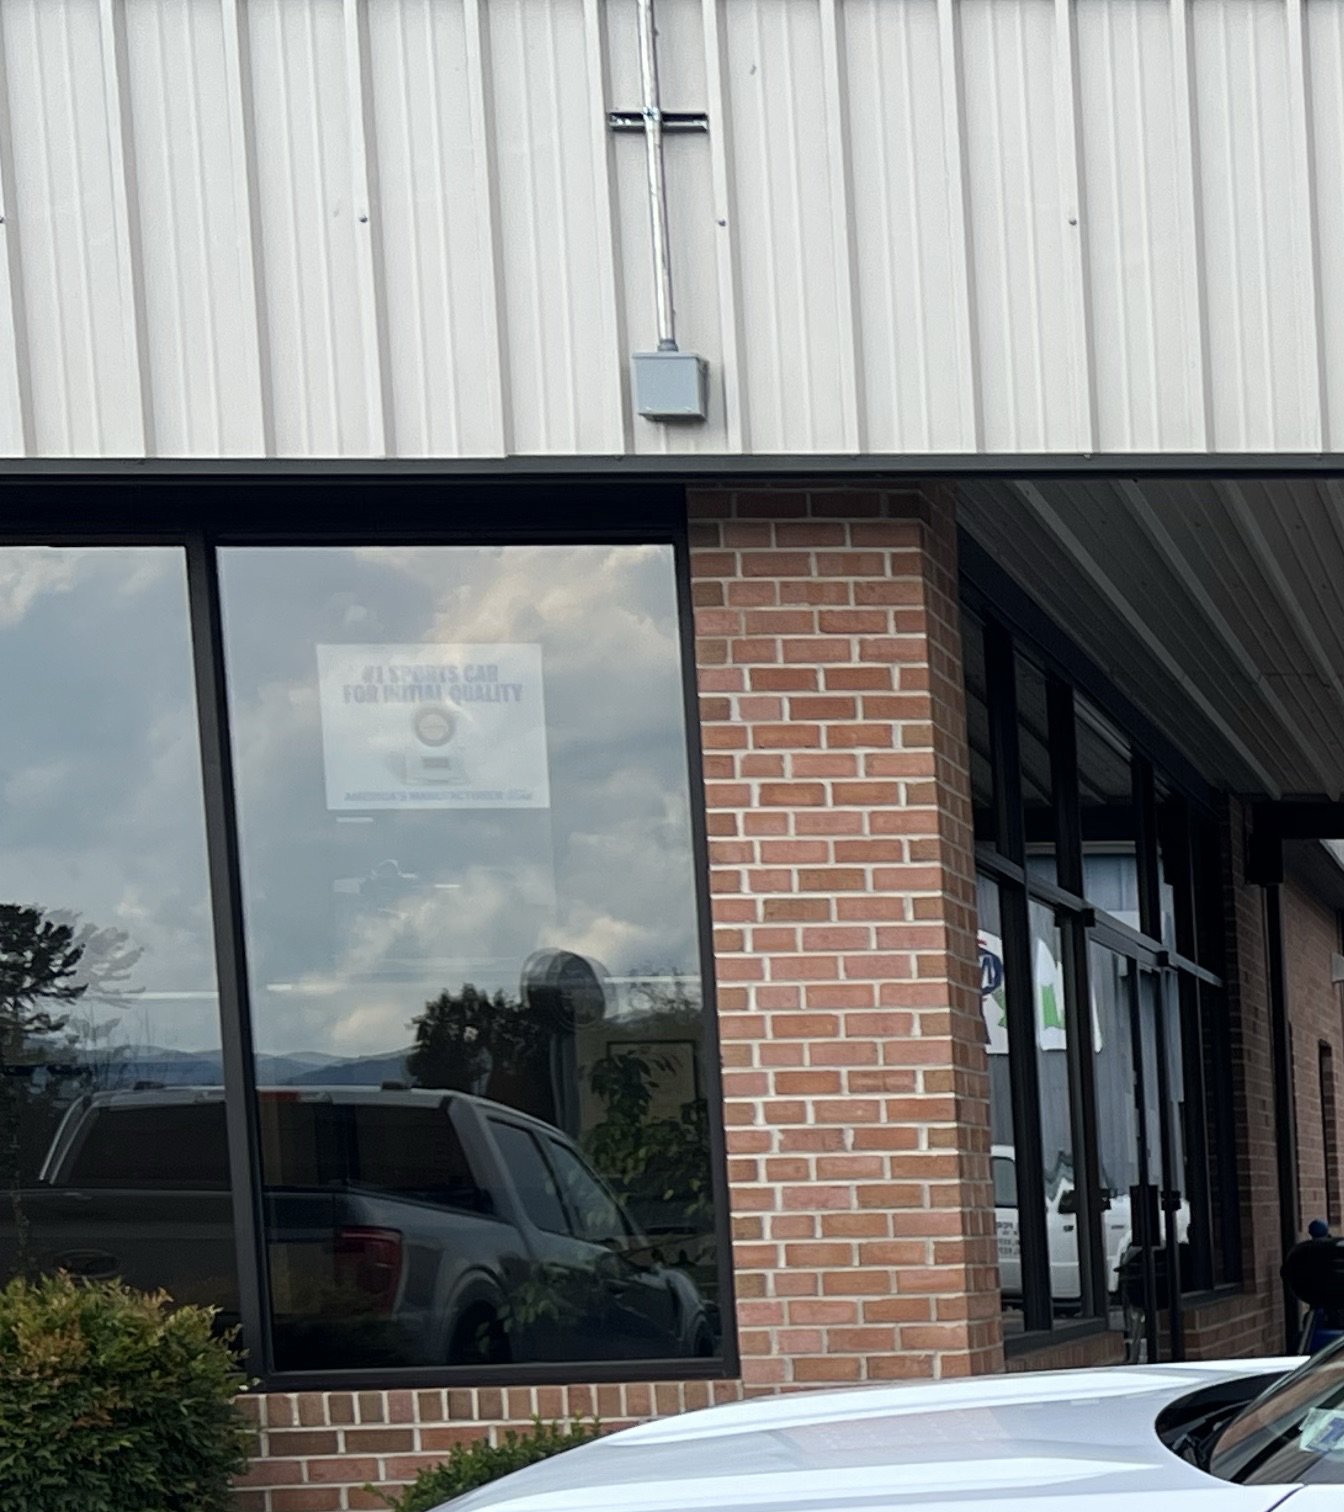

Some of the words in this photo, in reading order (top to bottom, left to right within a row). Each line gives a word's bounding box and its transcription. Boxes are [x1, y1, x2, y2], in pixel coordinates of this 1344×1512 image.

[463, 663, 499, 683] CAR
[343, 684, 379, 704] FOR
[447, 682, 523, 706] QUALITY
